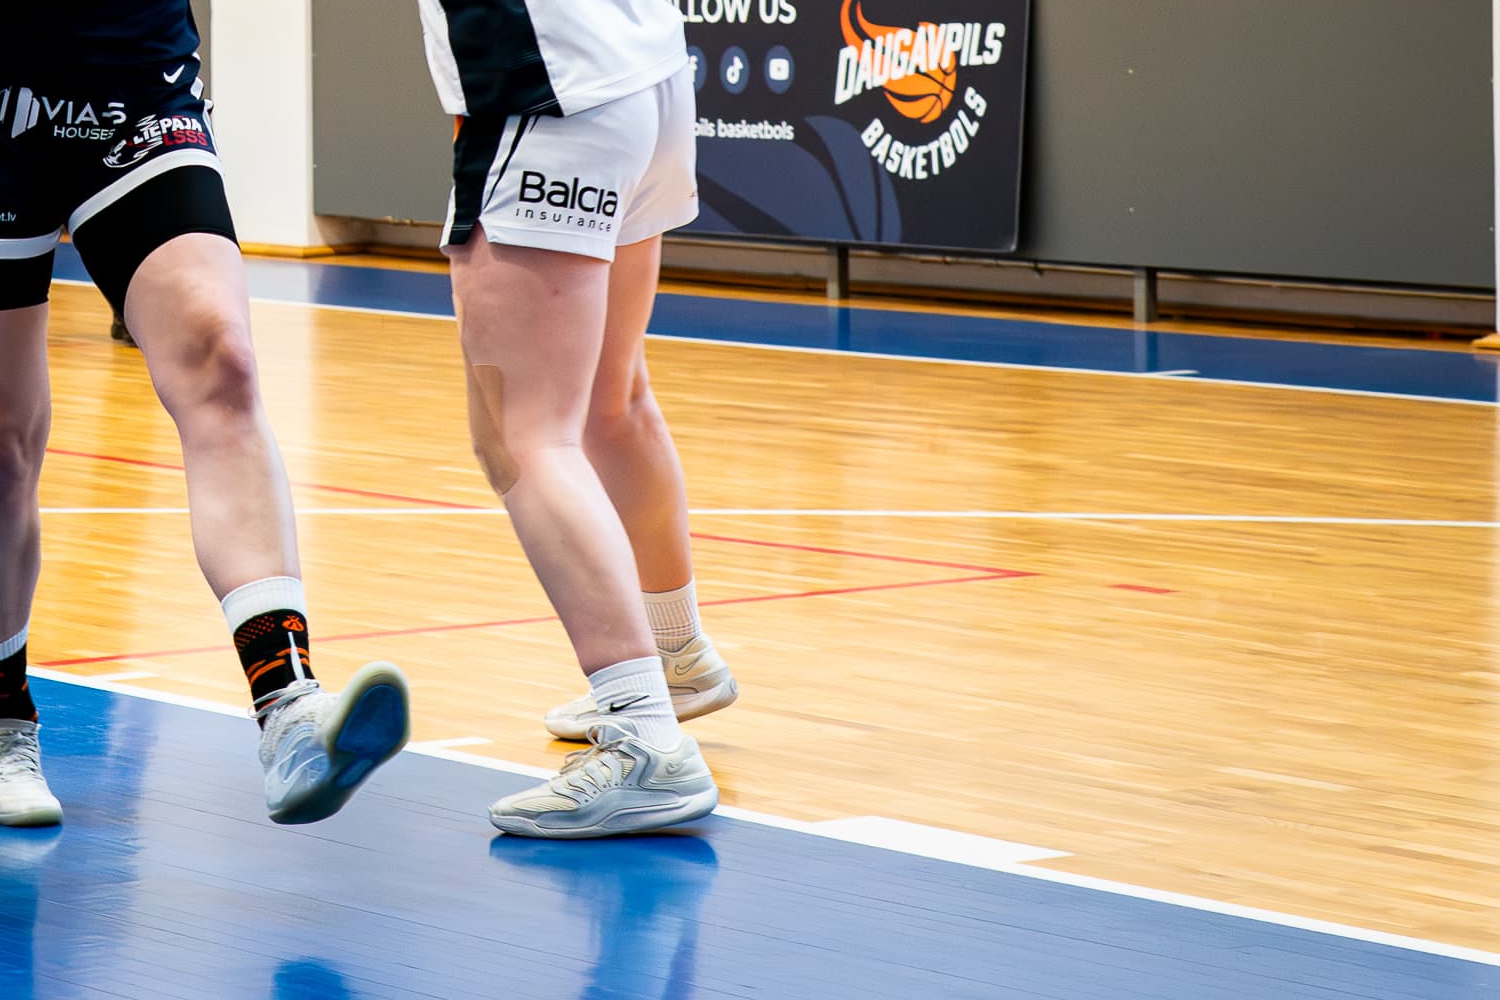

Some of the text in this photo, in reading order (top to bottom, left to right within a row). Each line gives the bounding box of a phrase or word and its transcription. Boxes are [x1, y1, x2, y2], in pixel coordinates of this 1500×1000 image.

[834, 22, 1006, 106] DAUGAVPILS
[53, 124, 116, 141] HOUSES
[717, 118, 795, 140] basketbols
[860, 86, 988, 180] BASKETBOLS
[518, 170, 619, 218] Balcia
[516, 207, 613, 233] insurance
